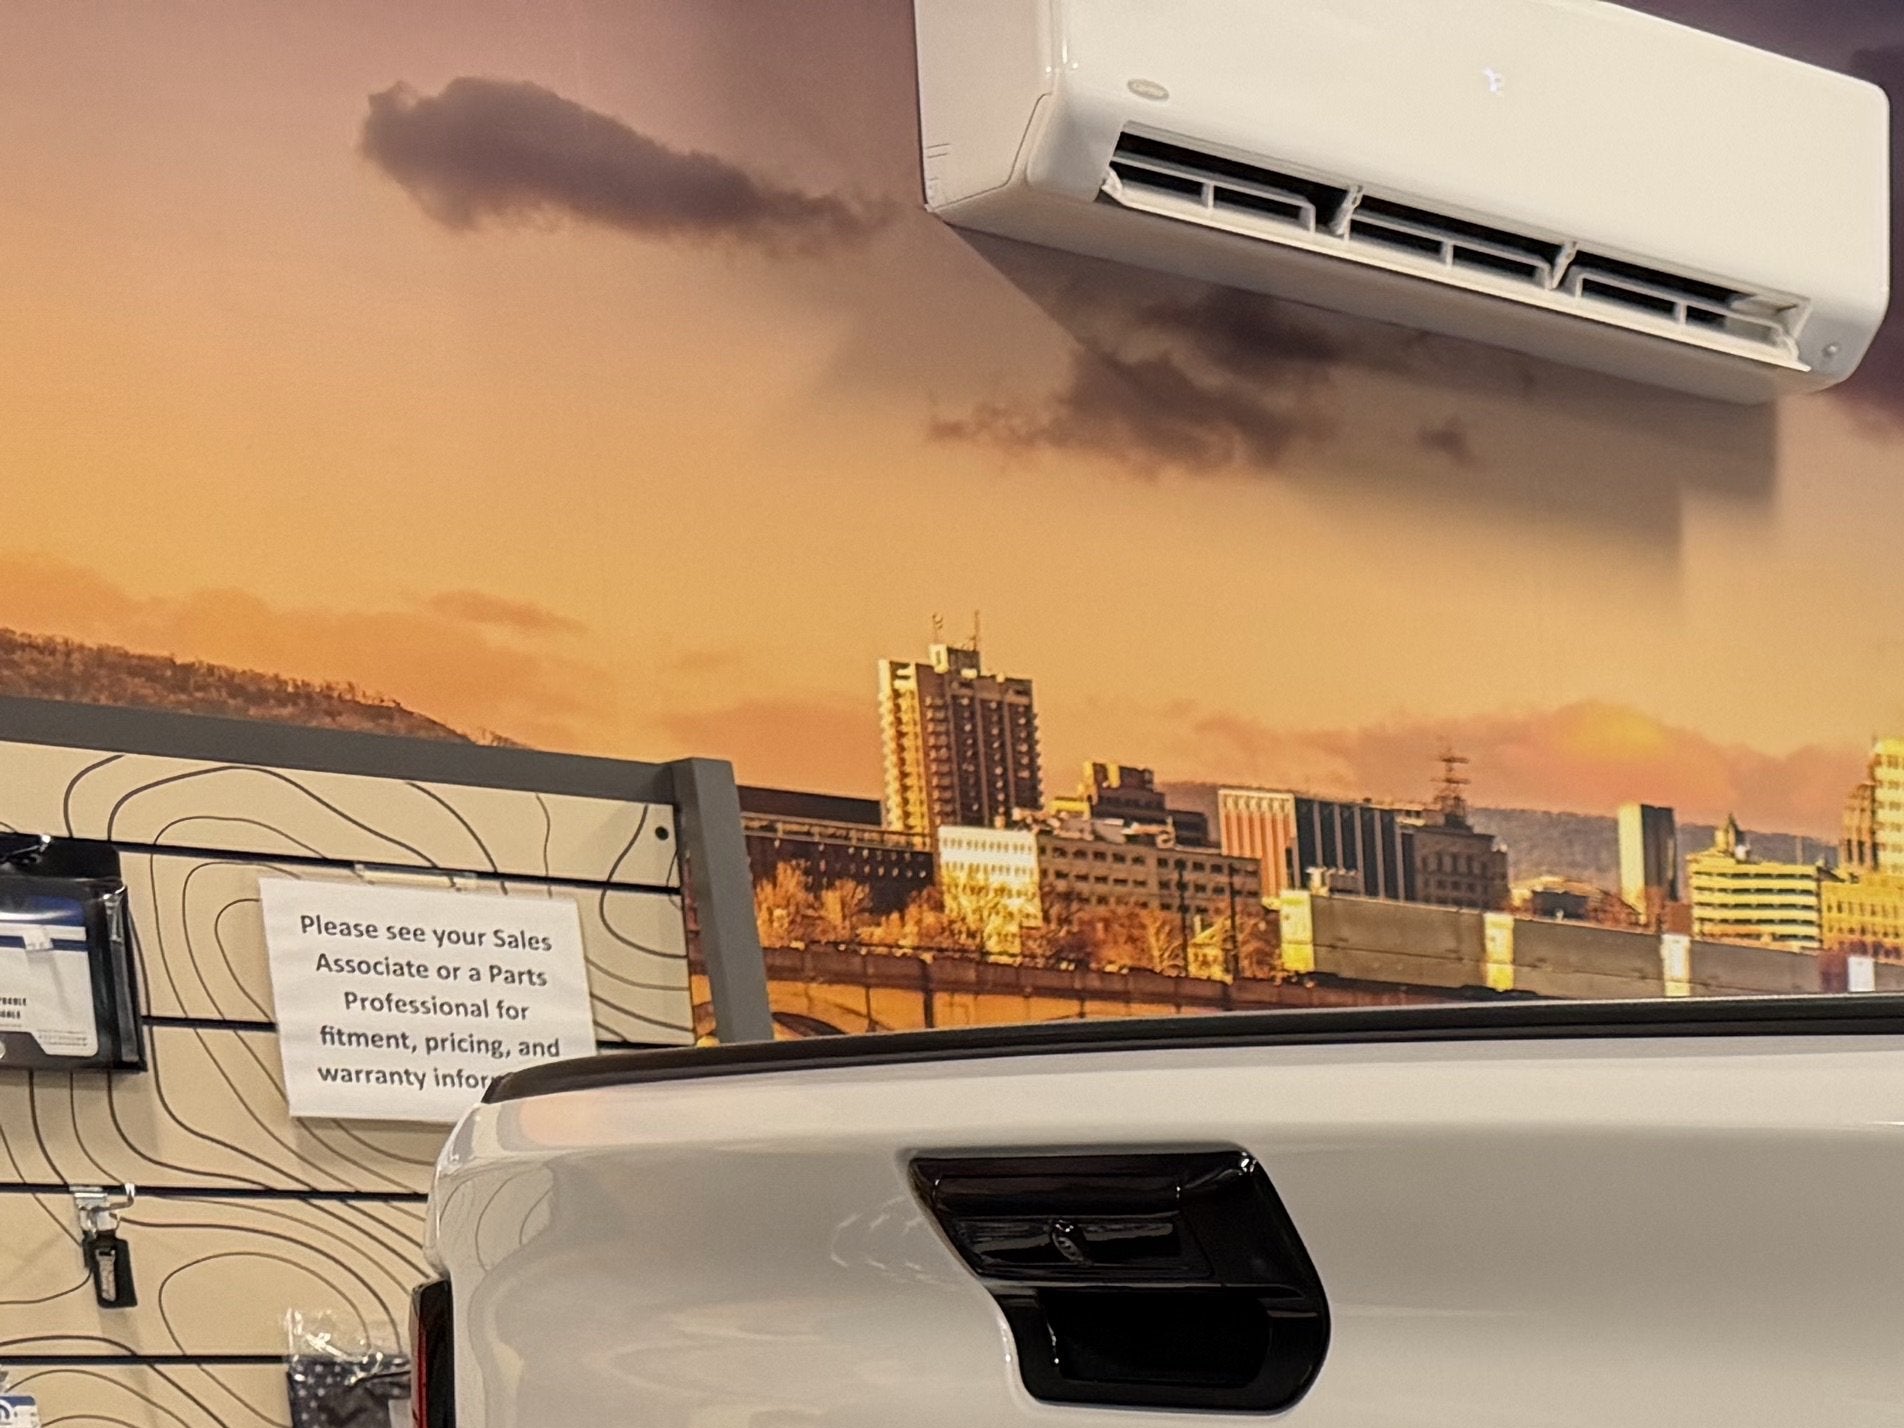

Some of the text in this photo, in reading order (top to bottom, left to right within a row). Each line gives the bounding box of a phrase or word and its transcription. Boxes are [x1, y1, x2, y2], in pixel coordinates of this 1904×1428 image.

[299, 914, 553, 952] Please see your Sales
[315, 953, 548, 988] Associate or a Parts
[343, 991, 529, 1020] Professional for
[319, 1025, 561, 1060] fitment, pricing, and
[317, 1065, 497, 1090] warranty infor
